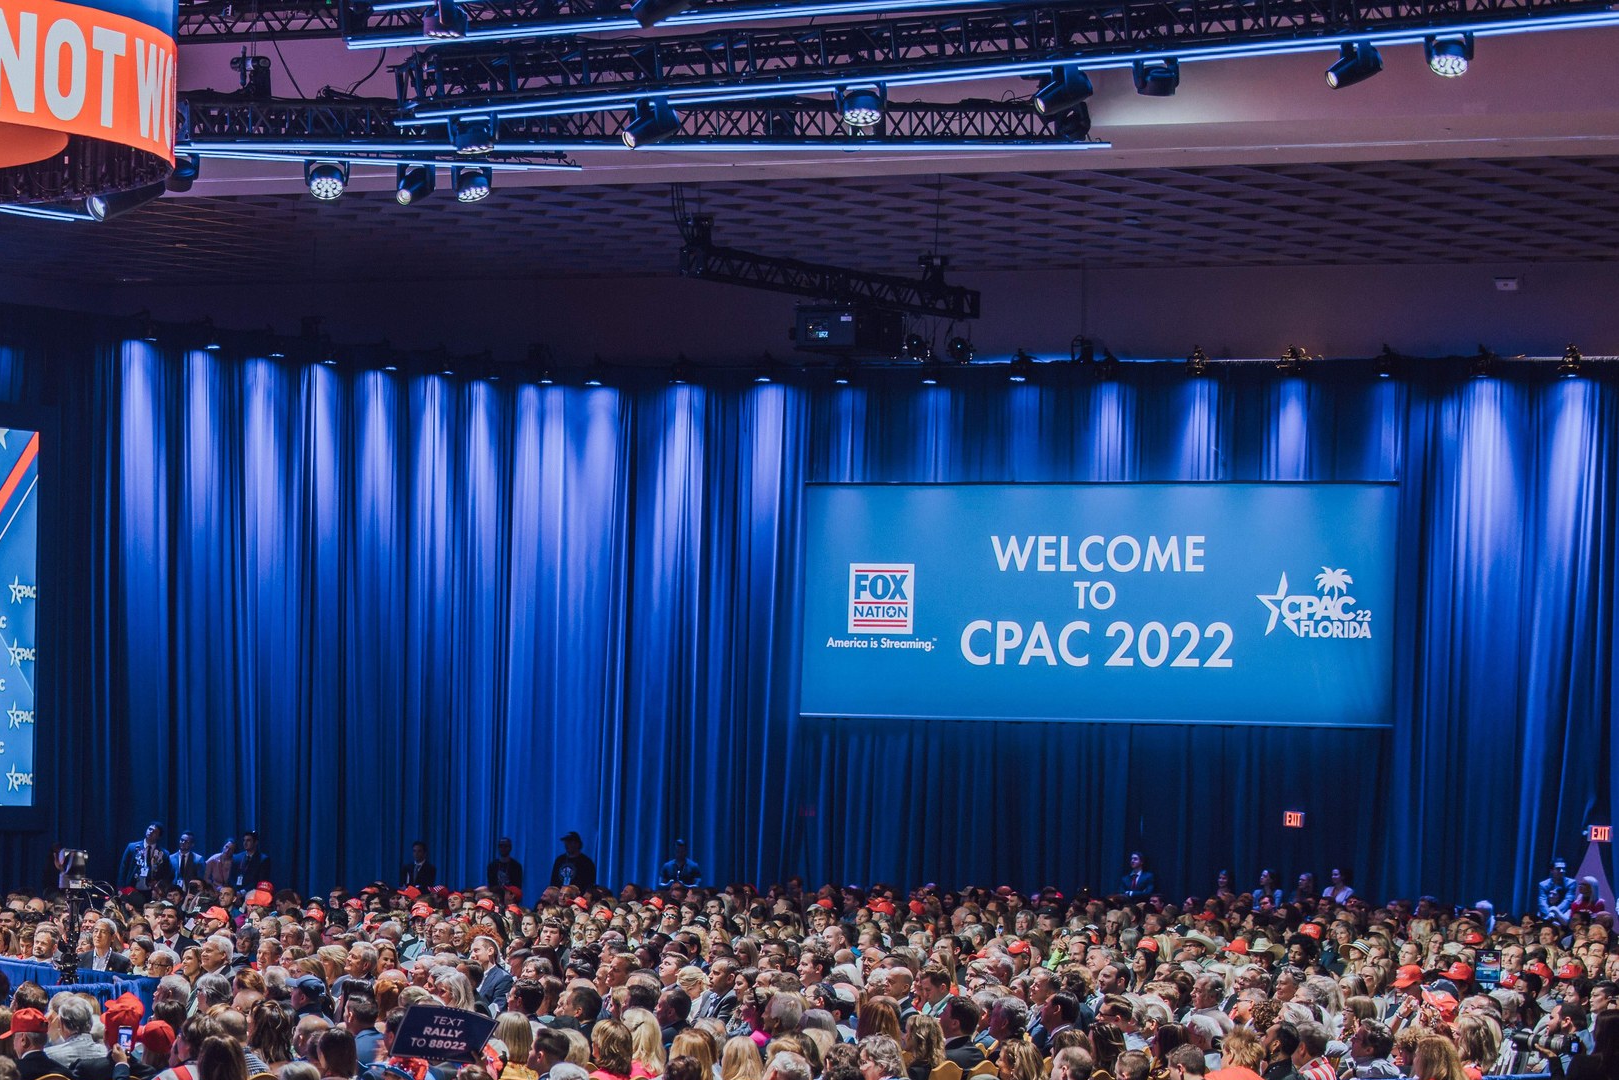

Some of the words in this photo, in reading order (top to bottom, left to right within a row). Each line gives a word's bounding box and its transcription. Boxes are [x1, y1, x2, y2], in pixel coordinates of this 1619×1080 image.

[991, 535, 1206, 573] WELCOME
[854, 574, 908, 600] FOX
[1073, 580, 1116, 611] TO
[854, 606, 908, 618] NATION
[1281, 595, 1357, 621] CPAC
[1356, 610, 1372, 622] 22
[1299, 620, 1372, 639] FLORIDA
[826, 637, 868, 648] America
[870, 638, 878, 648] is
[960, 621, 1090, 667] CPAC
[1103, 621, 1234, 668] 2022
[1286, 812, 1302, 827] EXIT
[1591, 826, 1610, 841] EXIT
[433, 1015, 464, 1027] TEXT
[422, 1026, 464, 1039] RALLY
[410, 1037, 427, 1048] TO
[428, 1039, 467, 1051] 88022
